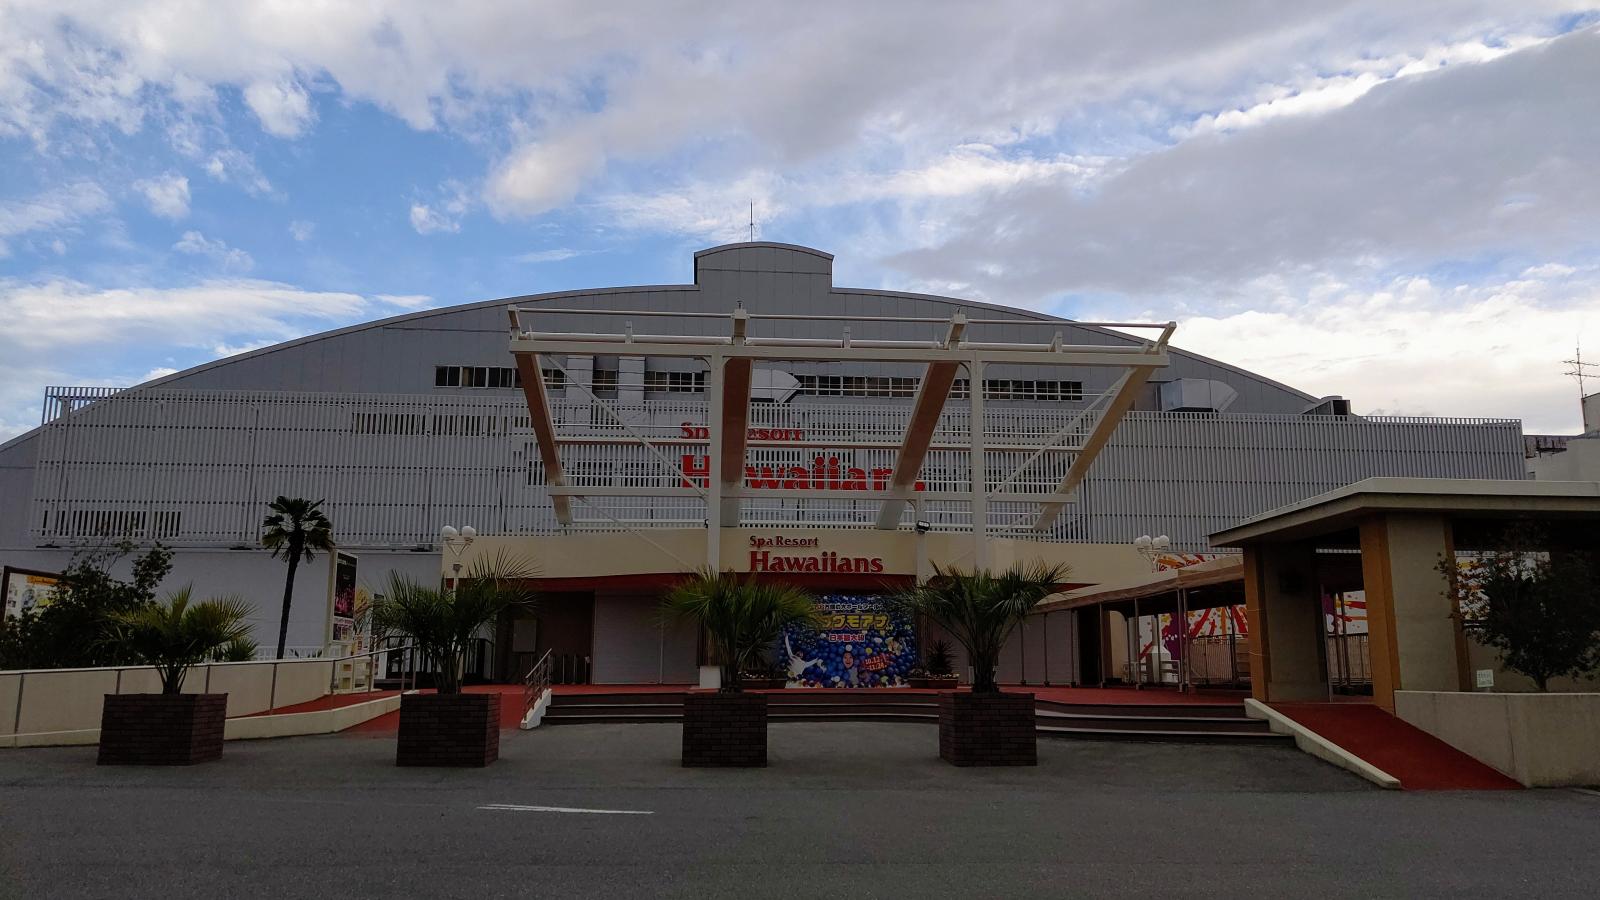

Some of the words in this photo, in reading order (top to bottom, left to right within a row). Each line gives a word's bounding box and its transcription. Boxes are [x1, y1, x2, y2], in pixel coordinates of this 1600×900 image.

[747, 426, 802, 441] esort
[682, 454, 925, 491] Hwaiian
[750, 535, 774, 548] Spa
[776, 535, 819, 547] Resort
[750, 550, 883, 573] Hawaiians
